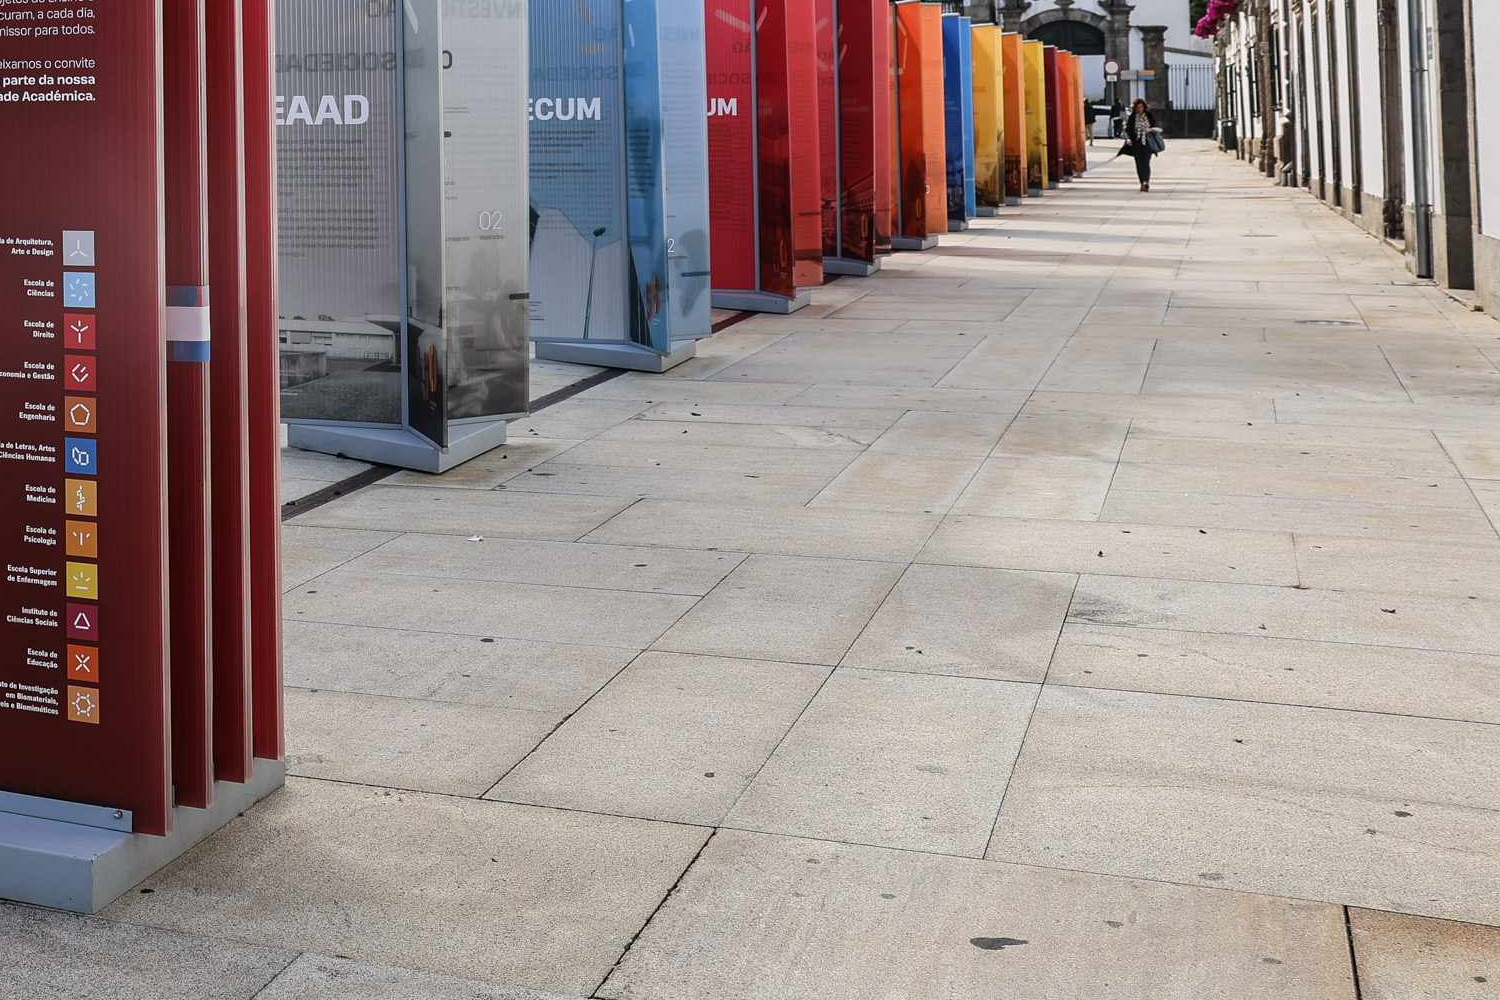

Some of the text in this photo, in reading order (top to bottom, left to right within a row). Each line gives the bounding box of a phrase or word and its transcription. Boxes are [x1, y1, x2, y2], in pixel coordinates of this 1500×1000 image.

[47, 8, 73, 19] cada
[77, 7, 95, 18] dia,
[35, 27, 58, 37] para
[61, 24, 95, 34] todos.
[55, 59, 95, 68] convite
[3, 76, 35, 87] parte
[58, 76, 95, 84] nossa
[22, 90, 95, 101] Académica.
[529, 98, 600, 120] CUM
[479, 211, 502, 230] 02
[16, 238, 53, 246] Arquitetura,
[32, 248, 53, 256] Design
[27, 289, 54, 297] Ciências
[33, 372, 54, 380] Gestão
[25, 402, 45, 410] Escola
[19, 412, 55, 421] Engenharia
[15, 443, 37, 452] Letras,
[26, 454, 55, 462] Humanas
[27, 495, 56, 503] Medicina
[24, 535, 56, 545] Psicologia
[8, 565, 57, 576] Escola Superior
[17, 576, 57, 586] Enfermagem
[22, 607, 48, 615] Instituto
[7, 615, 58, 627] Ciências Sociais
[28, 648, 48, 657] Escola
[27, 658, 58, 668] Educação
[19, 683, 58, 695] Investigação
[17, 693, 58, 705] Biomateriais,
[16, 703, 58, 714] Biomiméticos
